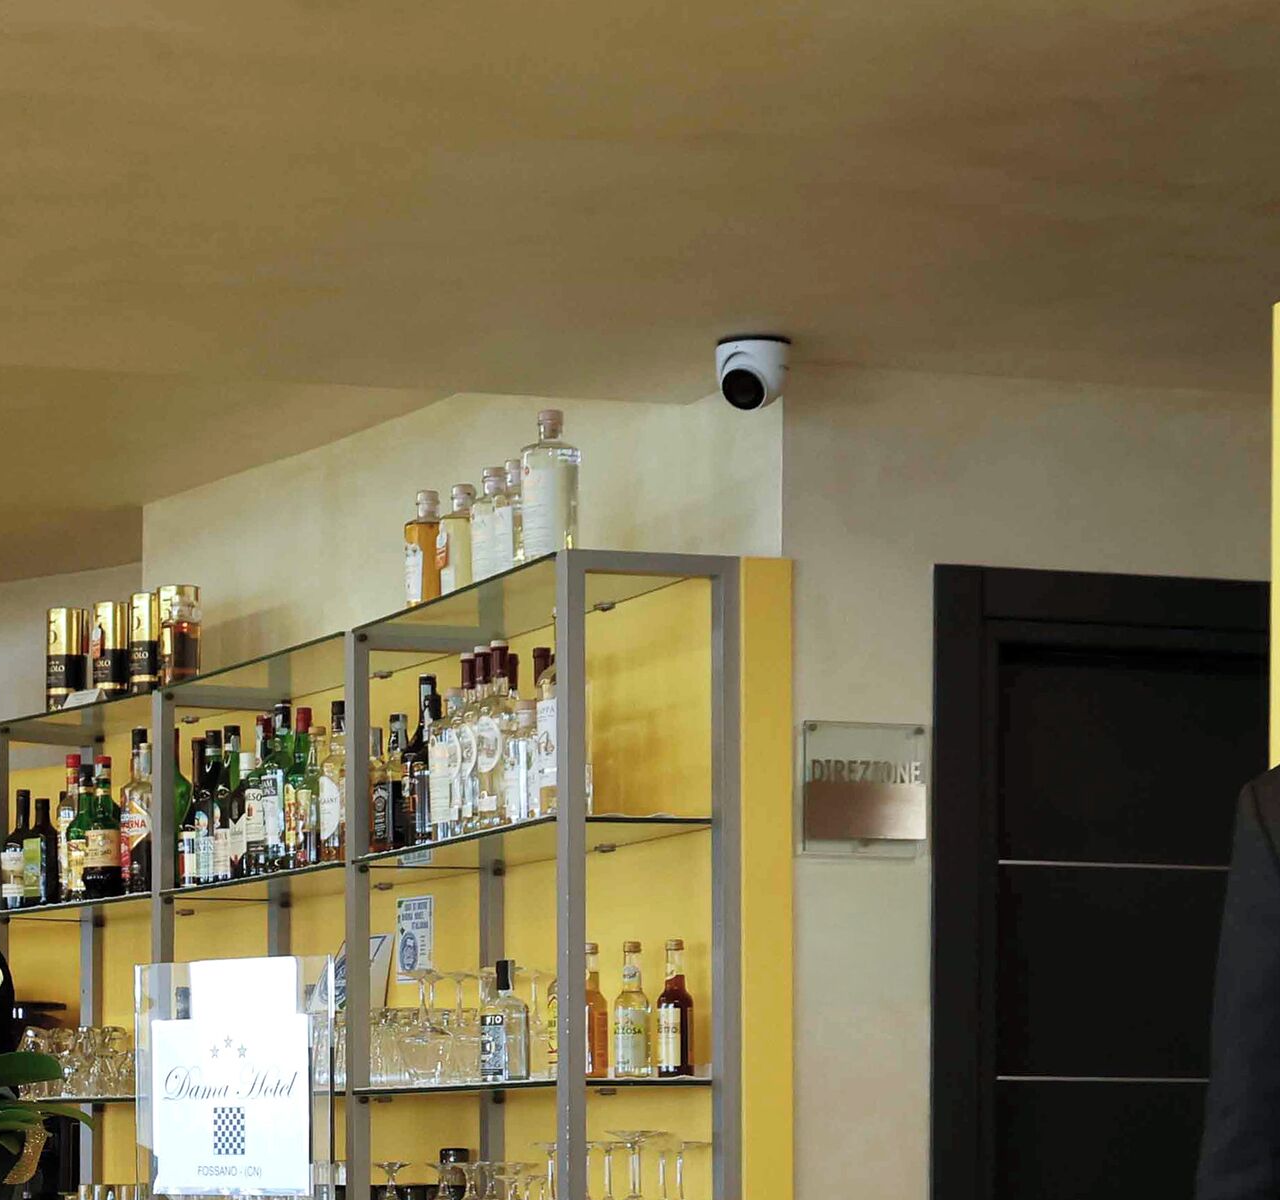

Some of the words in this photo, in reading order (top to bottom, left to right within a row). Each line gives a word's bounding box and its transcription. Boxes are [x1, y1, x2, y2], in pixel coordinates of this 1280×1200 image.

[811, 759, 921, 784] DIREZIONE
[162, 1066, 229, 1101] Dama
[236, 1068, 298, 1100] Hotel
[197, 1165, 238, 1177] FOSSANO
[244, 1165, 263, 1177] (CN)
